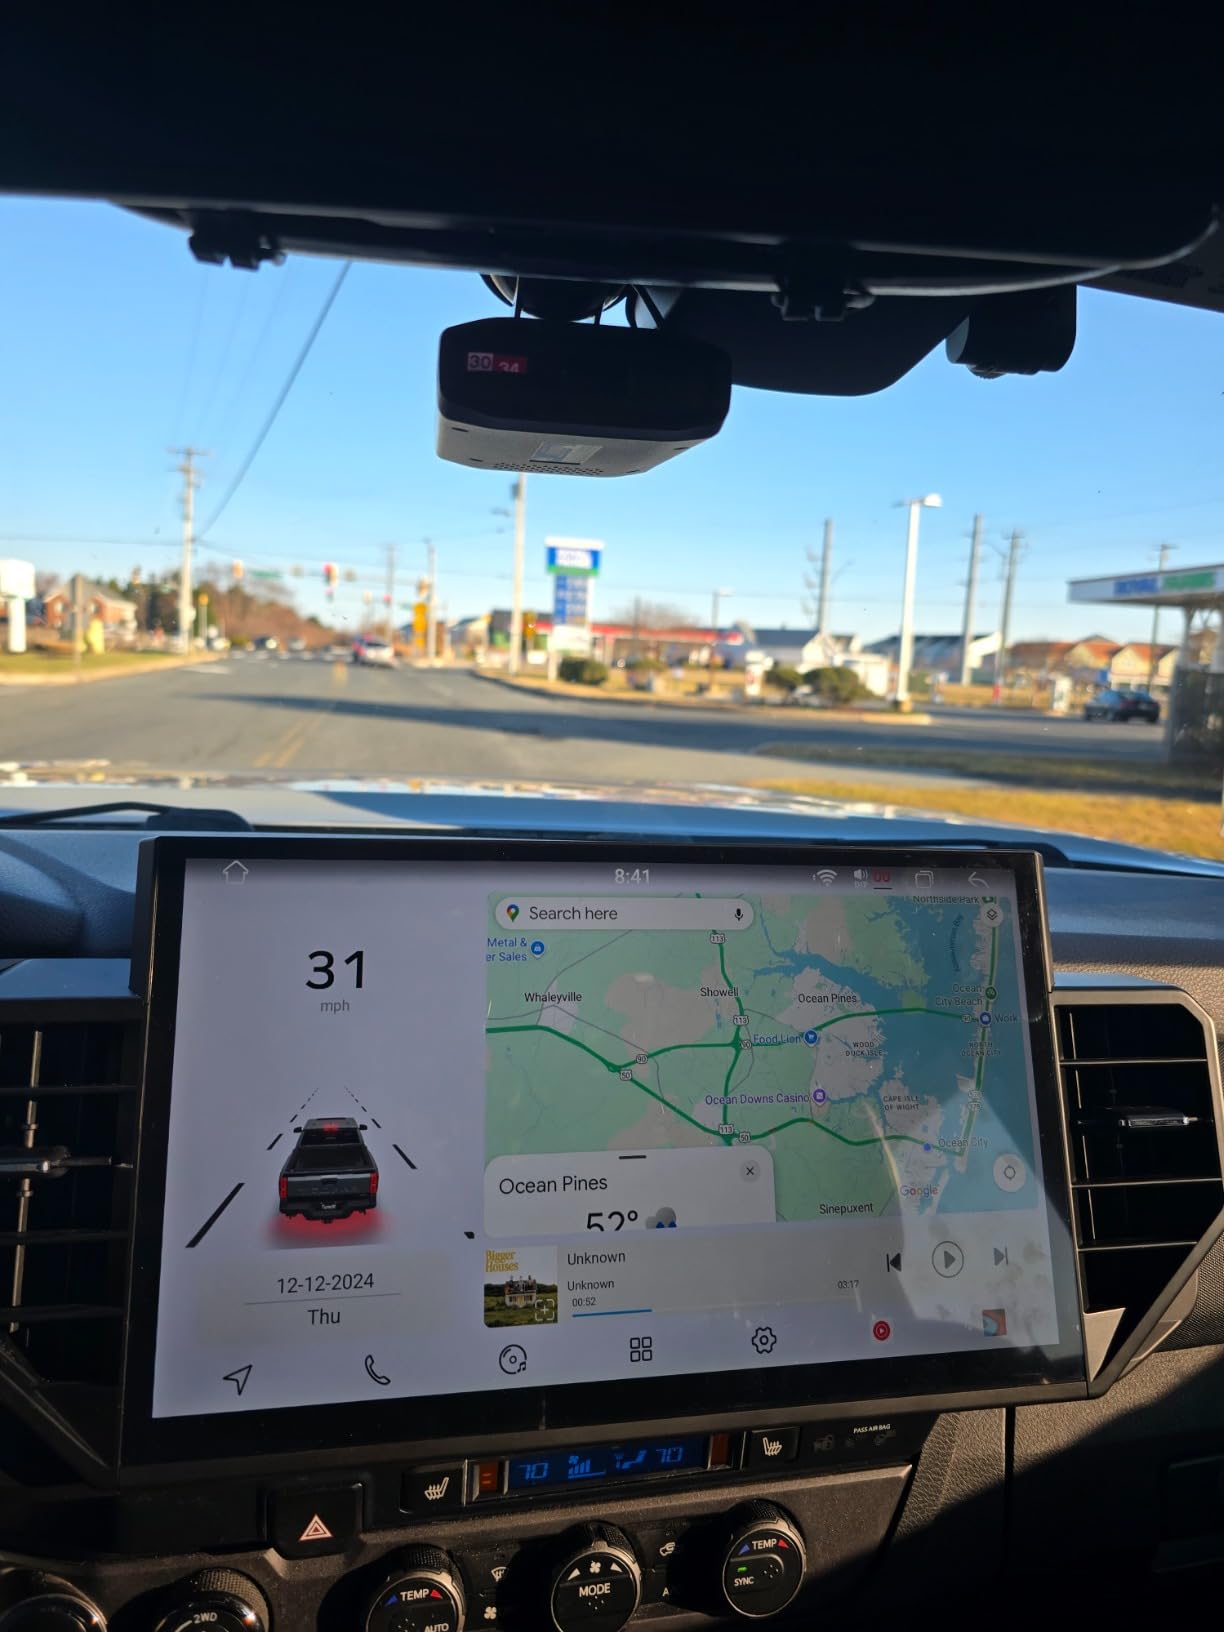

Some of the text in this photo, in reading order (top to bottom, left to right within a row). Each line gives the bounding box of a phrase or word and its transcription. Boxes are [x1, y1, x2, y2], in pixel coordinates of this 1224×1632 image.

[470, 354, 491, 369] 30
[615, 868, 650, 885] 8:41
[913, 894, 980, 904] Northside Park
[529, 905, 618, 920] Search here
[487, 937, 527, 948] Metal &
[712, 933, 723, 943] 113
[486, 952, 527, 962] er Sales
[305, 950, 365, 990] 31
[700, 987, 739, 998] Showell
[952, 984, 982, 993] Ocean
[524, 991, 583, 1004] Whaleyville
[798, 993, 857, 1004] Ocean Pines
[935, 997, 983, 1007] City Beach
[320, 1000, 350, 1015] mph
[734, 1016, 749, 1025] 113
[994, 1014, 1018, 1023] Work
[754, 1033, 801, 1045] Food Lion
[637, 1054, 646, 1063] 90
[621, 1070, 631, 1080] 50
[705, 1093, 809, 1105] Ocean Downs Casino
[720, 1125, 732, 1134] 113
[740, 1134, 749, 1143] 50
[938, 1136, 989, 1149] Ocean City
[499, 1175, 608, 1195] Ocean Pines
[900, 1183, 938, 1199] Google
[819, 1202, 874, 1215] Sinepuxent
[485, 1249, 516, 1264] Bigger
[567, 1251, 626, 1267] Unknown
[485, 1261, 519, 1273] Houses
[277, 1273, 374, 1294] 12-12-2024
[567, 1279, 615, 1292] Unknown
[837, 1279, 859, 1289] 03:17
[572, 1297, 596, 1308] 00:52
[307, 1308, 341, 1326] Thu
[853, 1427, 868, 1435] PASS
[655, 1446, 683, 1464] 70
[519, 1462, 548, 1481] 70
[752, 1538, 777, 1552] TEMP
[733, 1577, 755, 1588] SYNC
[400, 1588, 430, 1602] TEMP
[579, 1582, 612, 1598] MODE
[193, 1612, 218, 1625] 2WD
[424, 1621, 449, 1632] AUTO
